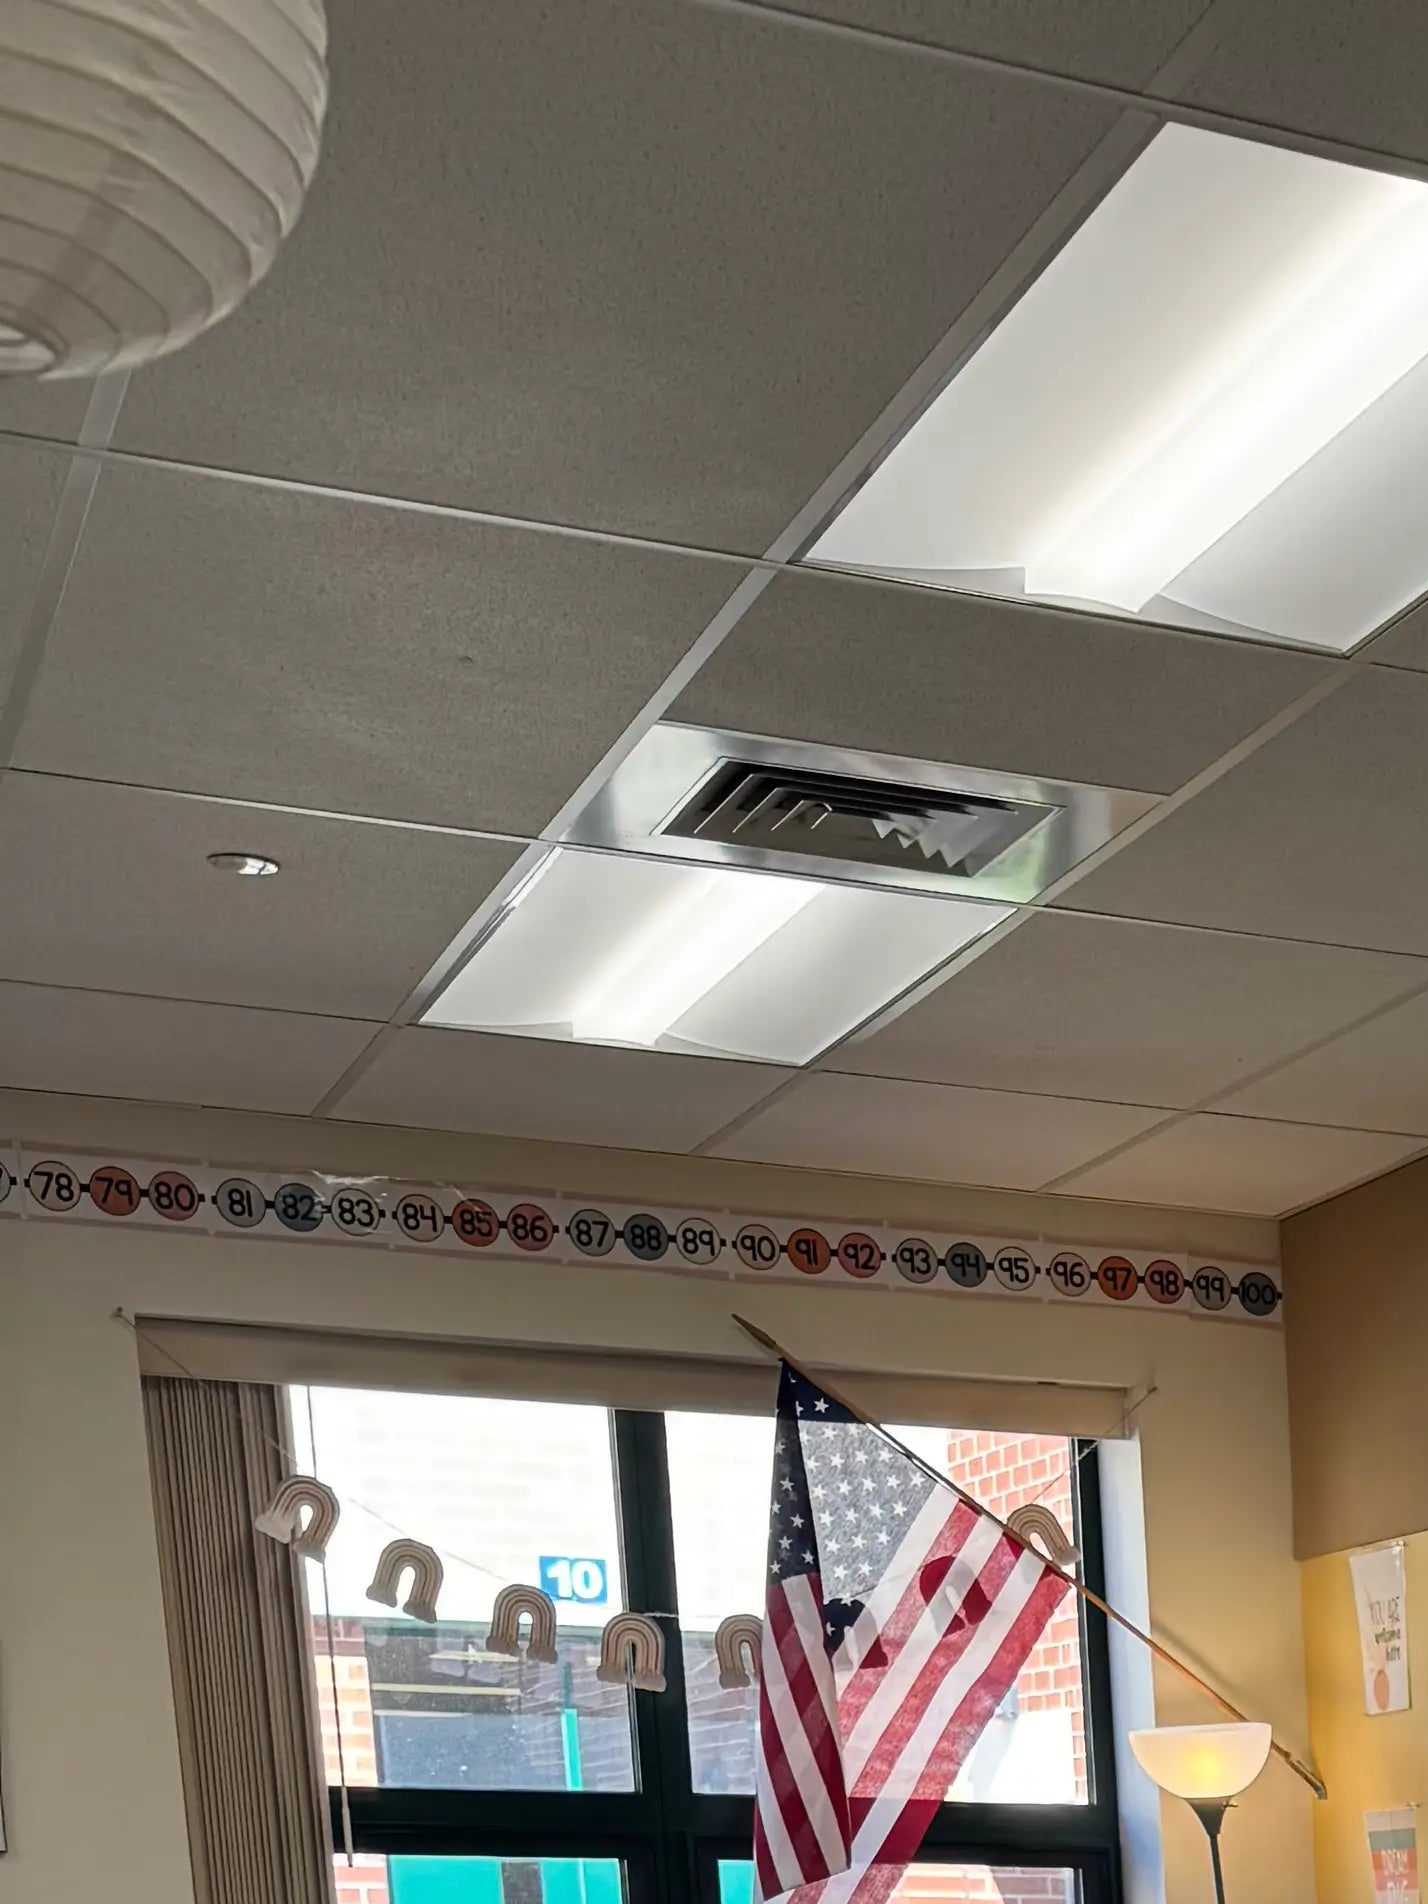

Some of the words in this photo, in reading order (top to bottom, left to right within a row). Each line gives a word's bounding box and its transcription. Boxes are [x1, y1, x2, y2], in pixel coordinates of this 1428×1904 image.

[34, 1171, 75, 1202] 78
[95, 1178, 135, 1208] 79
[154, 1182, 193, 1211] 80
[227, 1188, 256, 1218] 81
[281, 1193, 317, 1222] 82
[338, 1197, 376, 1226] 83
[401, 1202, 439, 1233] 84
[458, 1208, 494, 1237] 85
[511, 1213, 548, 1242] 86
[575, 1218, 610, 1248] 87
[629, 1223, 662, 1252] 88
[681, 1227, 717, 1257] 89
[739, 1234, 776, 1263] 90
[791, 1238, 820, 1268] 91
[843, 1242, 877, 1271] 92
[900, 1246, 933, 1275] 93
[950, 1250, 983, 1280] 94
[999, 1255, 1031, 1284] 95
[1053, 1259, 1086, 1288] 96
[1102, 1263, 1132, 1293] 97
[1150, 1268, 1181, 1296] 98
[1196, 1273, 1226, 1304] 99
[1240, 1279, 1277, 1306] 100
[546, 1559, 602, 1598] 10
